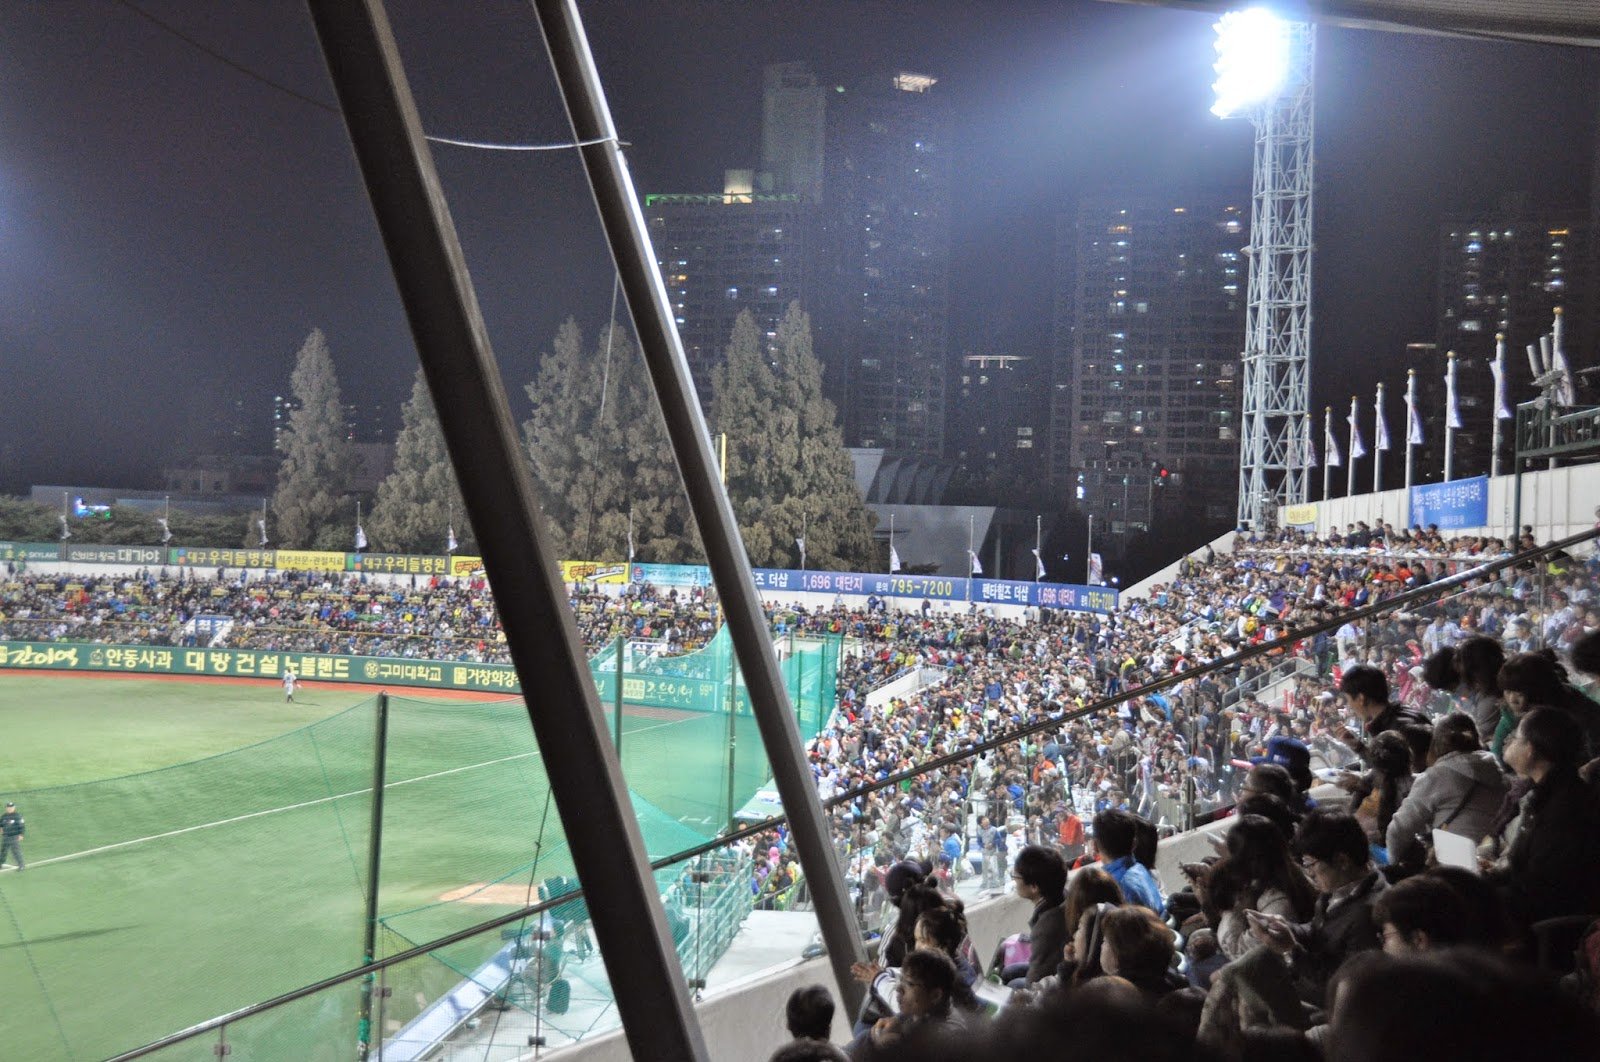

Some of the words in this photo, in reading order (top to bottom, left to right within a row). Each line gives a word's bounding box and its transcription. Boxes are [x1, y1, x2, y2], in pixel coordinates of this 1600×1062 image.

[117, 549, 160, 563] 대가야
[187, 551, 208, 565] 대구
[209, 551, 274, 567] 우리들병원
[364, 557, 382, 569] 대구
[384, 556, 446, 573] 우리들병원
[769, 573, 788, 588] 더샵
[802, 574, 831, 590] 1,696
[835, 576, 863, 592] 대단지
[890, 579, 952, 596] 795-7200
[1014, 585, 1029, 602] 더샵
[1037, 588, 1057, 604] 1,696
[106, 649, 173, 669] 안동사과
[379, 664, 442, 682] 구미대학교
